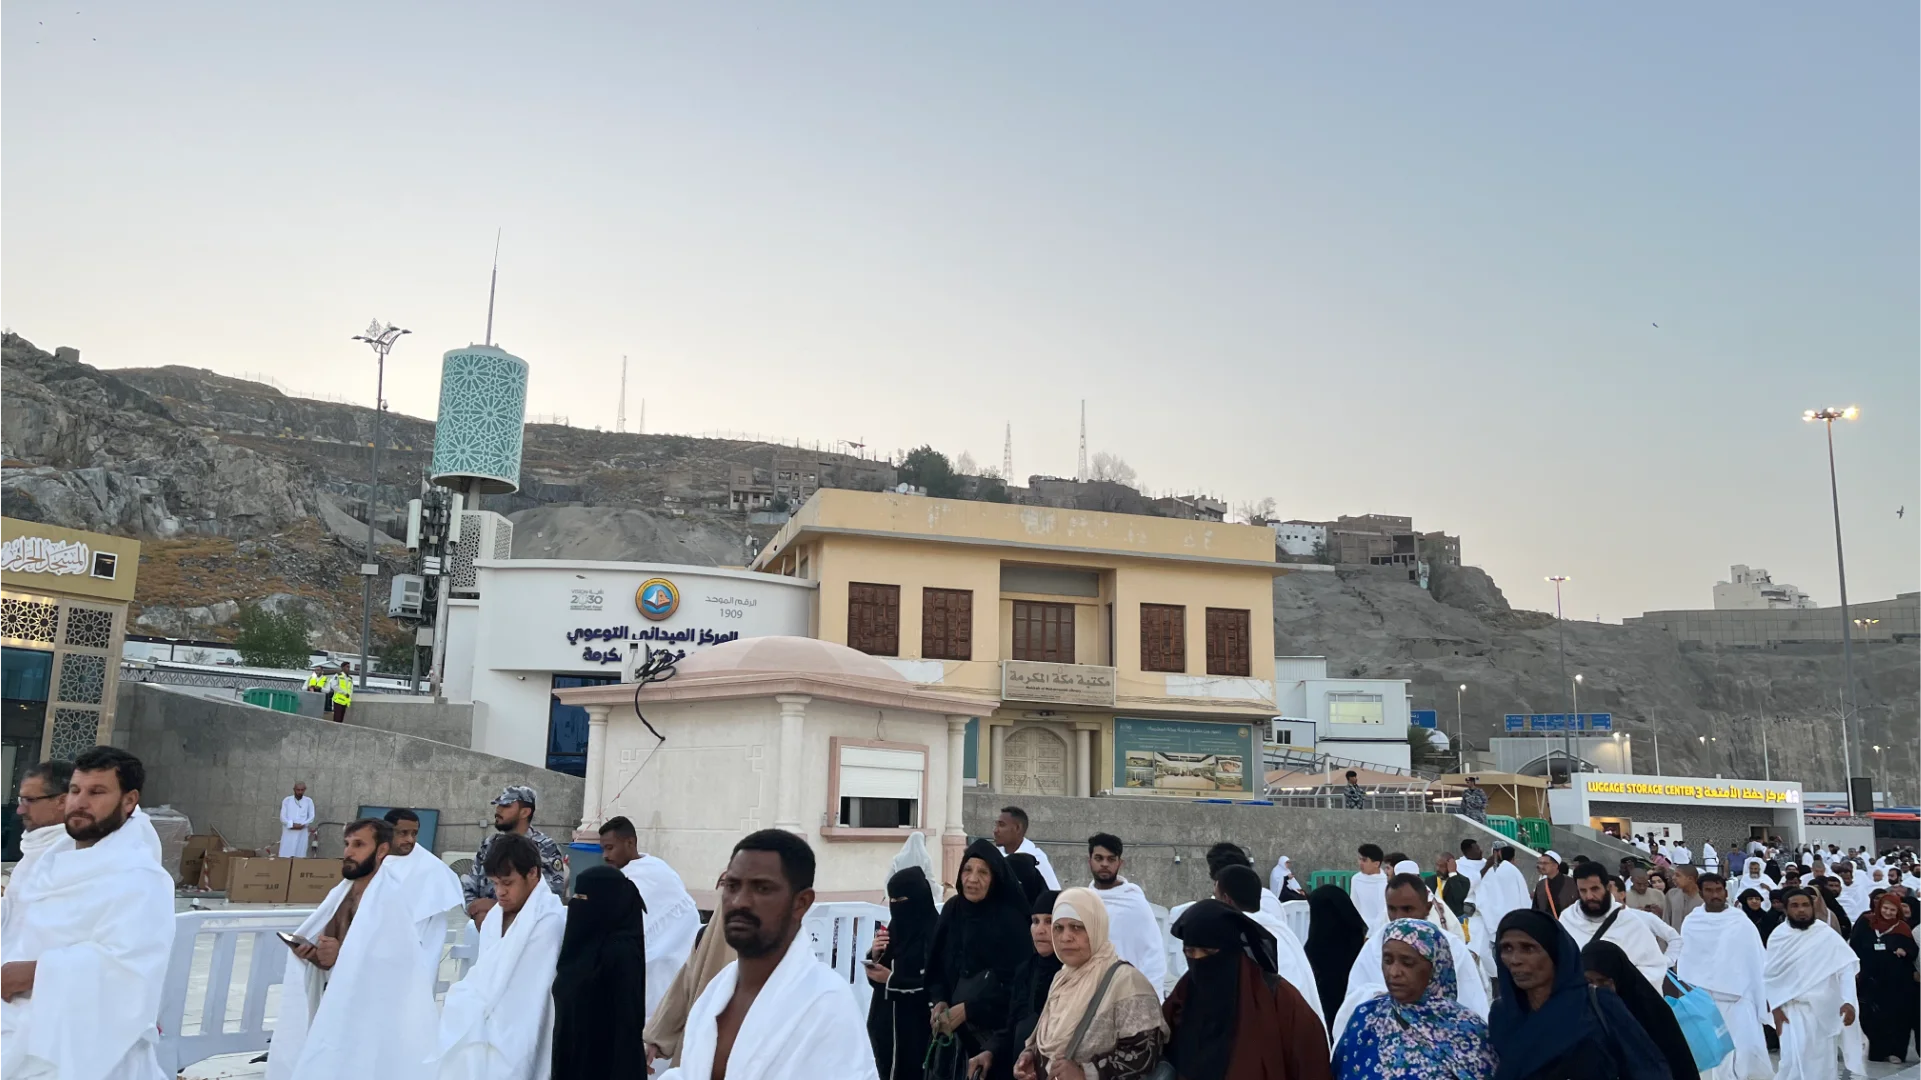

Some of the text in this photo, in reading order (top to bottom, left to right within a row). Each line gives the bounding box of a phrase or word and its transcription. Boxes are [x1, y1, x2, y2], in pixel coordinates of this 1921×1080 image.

[41, 540, 89, 576] المسجد
[705, 595, 757, 607] الرقم الموحد
[720, 608, 743, 619] 1909
[566, 625, 629, 646] التوعوي
[697, 628, 738, 646] المركز
[1009, 670, 1111, 688] مكتبة مكة المكرمة
[1587, 781, 1695, 796] LUGGAGE STORAGE CENTER
[1694, 785, 1786, 803] مركز حفظ الأمتعة 3
